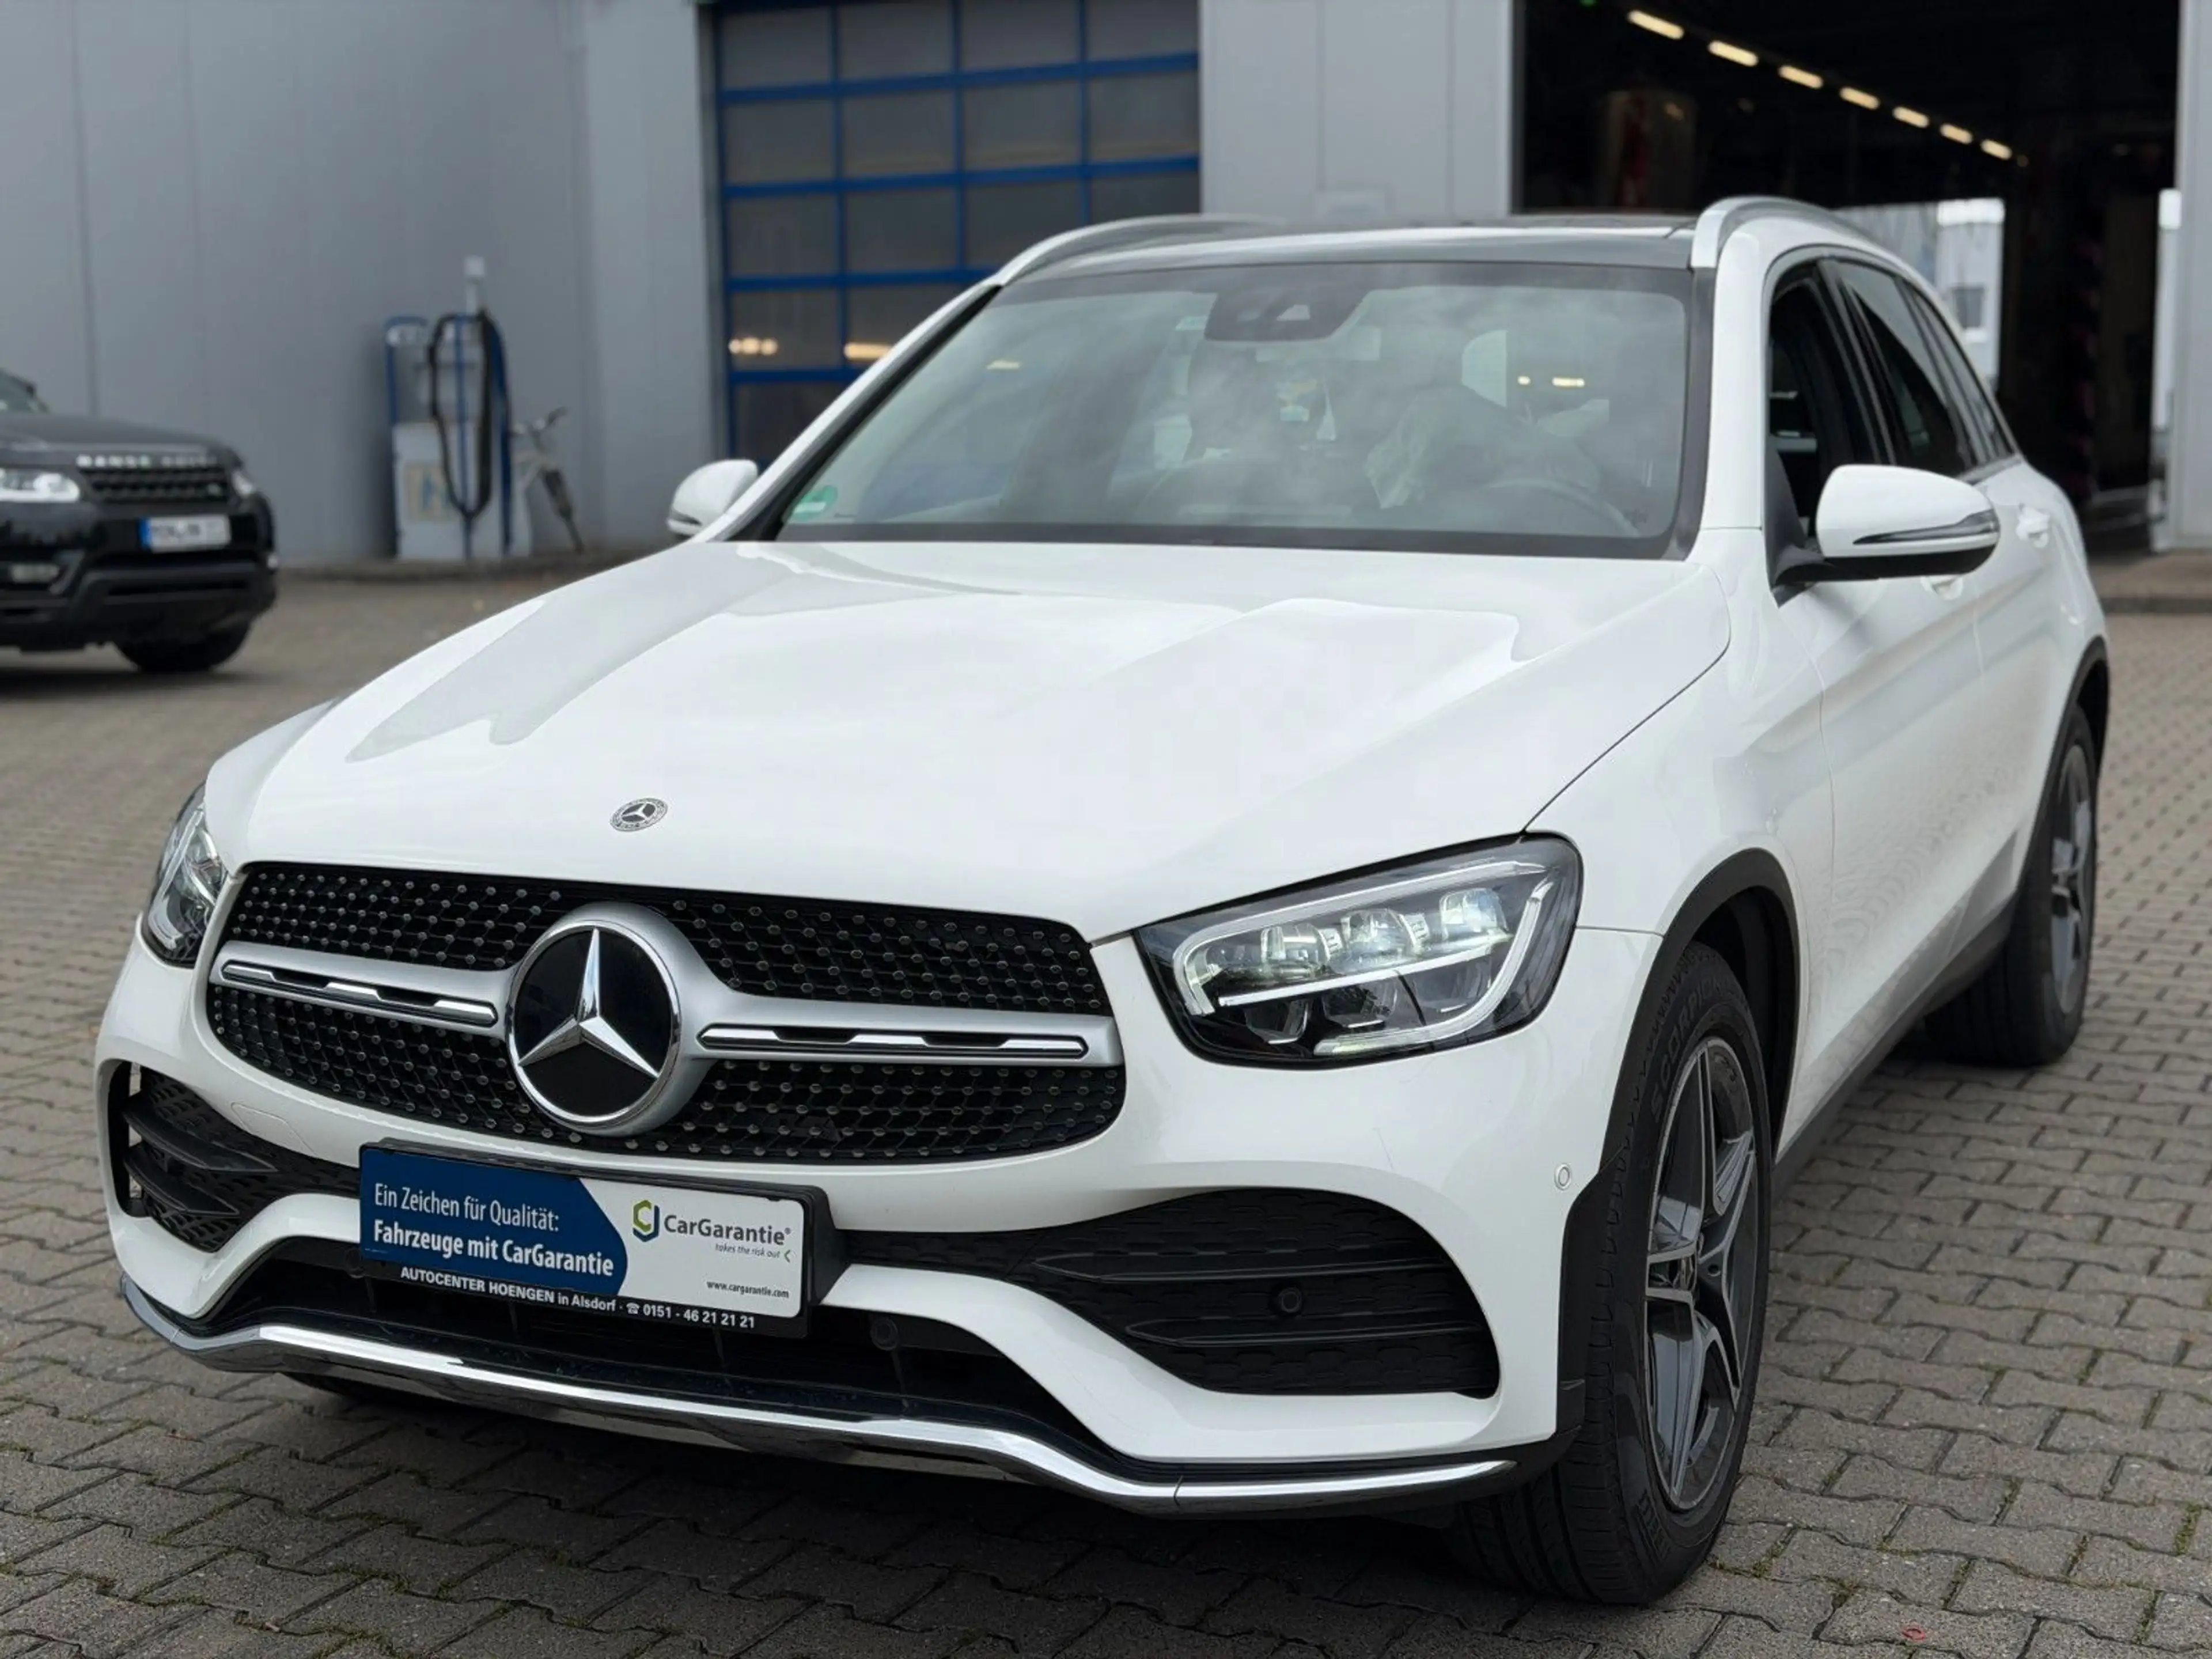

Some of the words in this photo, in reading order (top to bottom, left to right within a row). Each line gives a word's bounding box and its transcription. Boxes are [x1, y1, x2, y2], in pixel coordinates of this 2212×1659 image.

[374, 1183, 397, 1209] Ein
[401, 1187, 460, 1218] Zeichen
[464, 1195, 487, 1221] für
[490, 1199, 559, 1232] Qualität:
[374, 1219, 463, 1259] Fahrzeuge
[468, 1236, 499, 1260] mit
[502, 1239, 613, 1277] CarGarantie
[715, 1243, 736, 1253] takes
[737, 1244, 750, 1254] the
[751, 1247, 765, 1257] risk
[767, 1249, 781, 1259] out
[400, 1266, 486, 1293] AUTOCENTER
[489, 1281, 554, 1304] HOENGEN
[558, 1292, 569, 1306] in
[571, 1294, 616, 1312] Alsdorf
[643, 1304, 672, 1319] 0151
[683, 1309, 699, 1322] 46
[702, 1310, 717, 1324] 21
[721, 1313, 736, 1326] 21
[740, 1315, 755, 1328] 21
[706, 1280, 789, 1298] www.cargarantie.com
